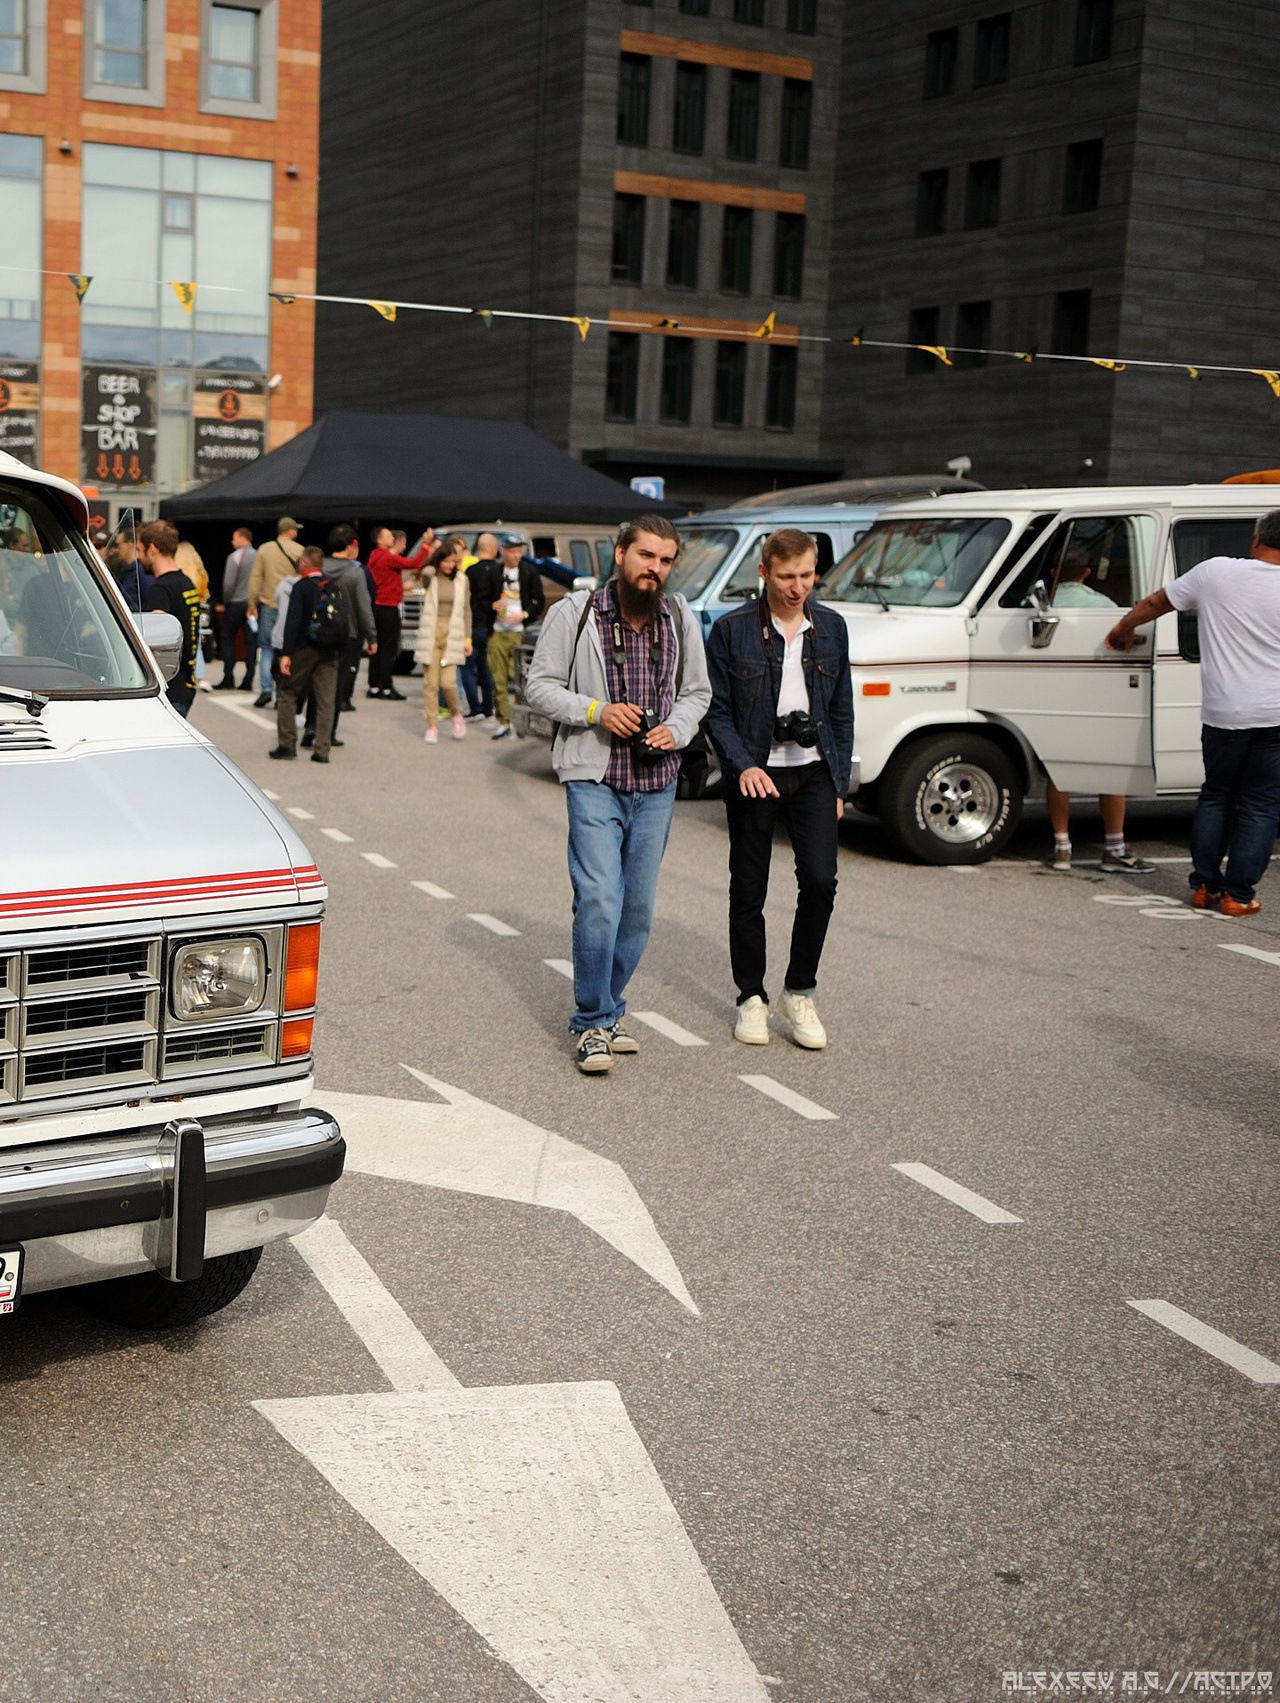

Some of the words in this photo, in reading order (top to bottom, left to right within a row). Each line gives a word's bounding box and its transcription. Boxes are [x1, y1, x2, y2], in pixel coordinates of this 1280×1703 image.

[98, 374, 141, 394] BEER
[97, 404, 141, 424] SHOP
[98, 427, 139, 451] BAR
